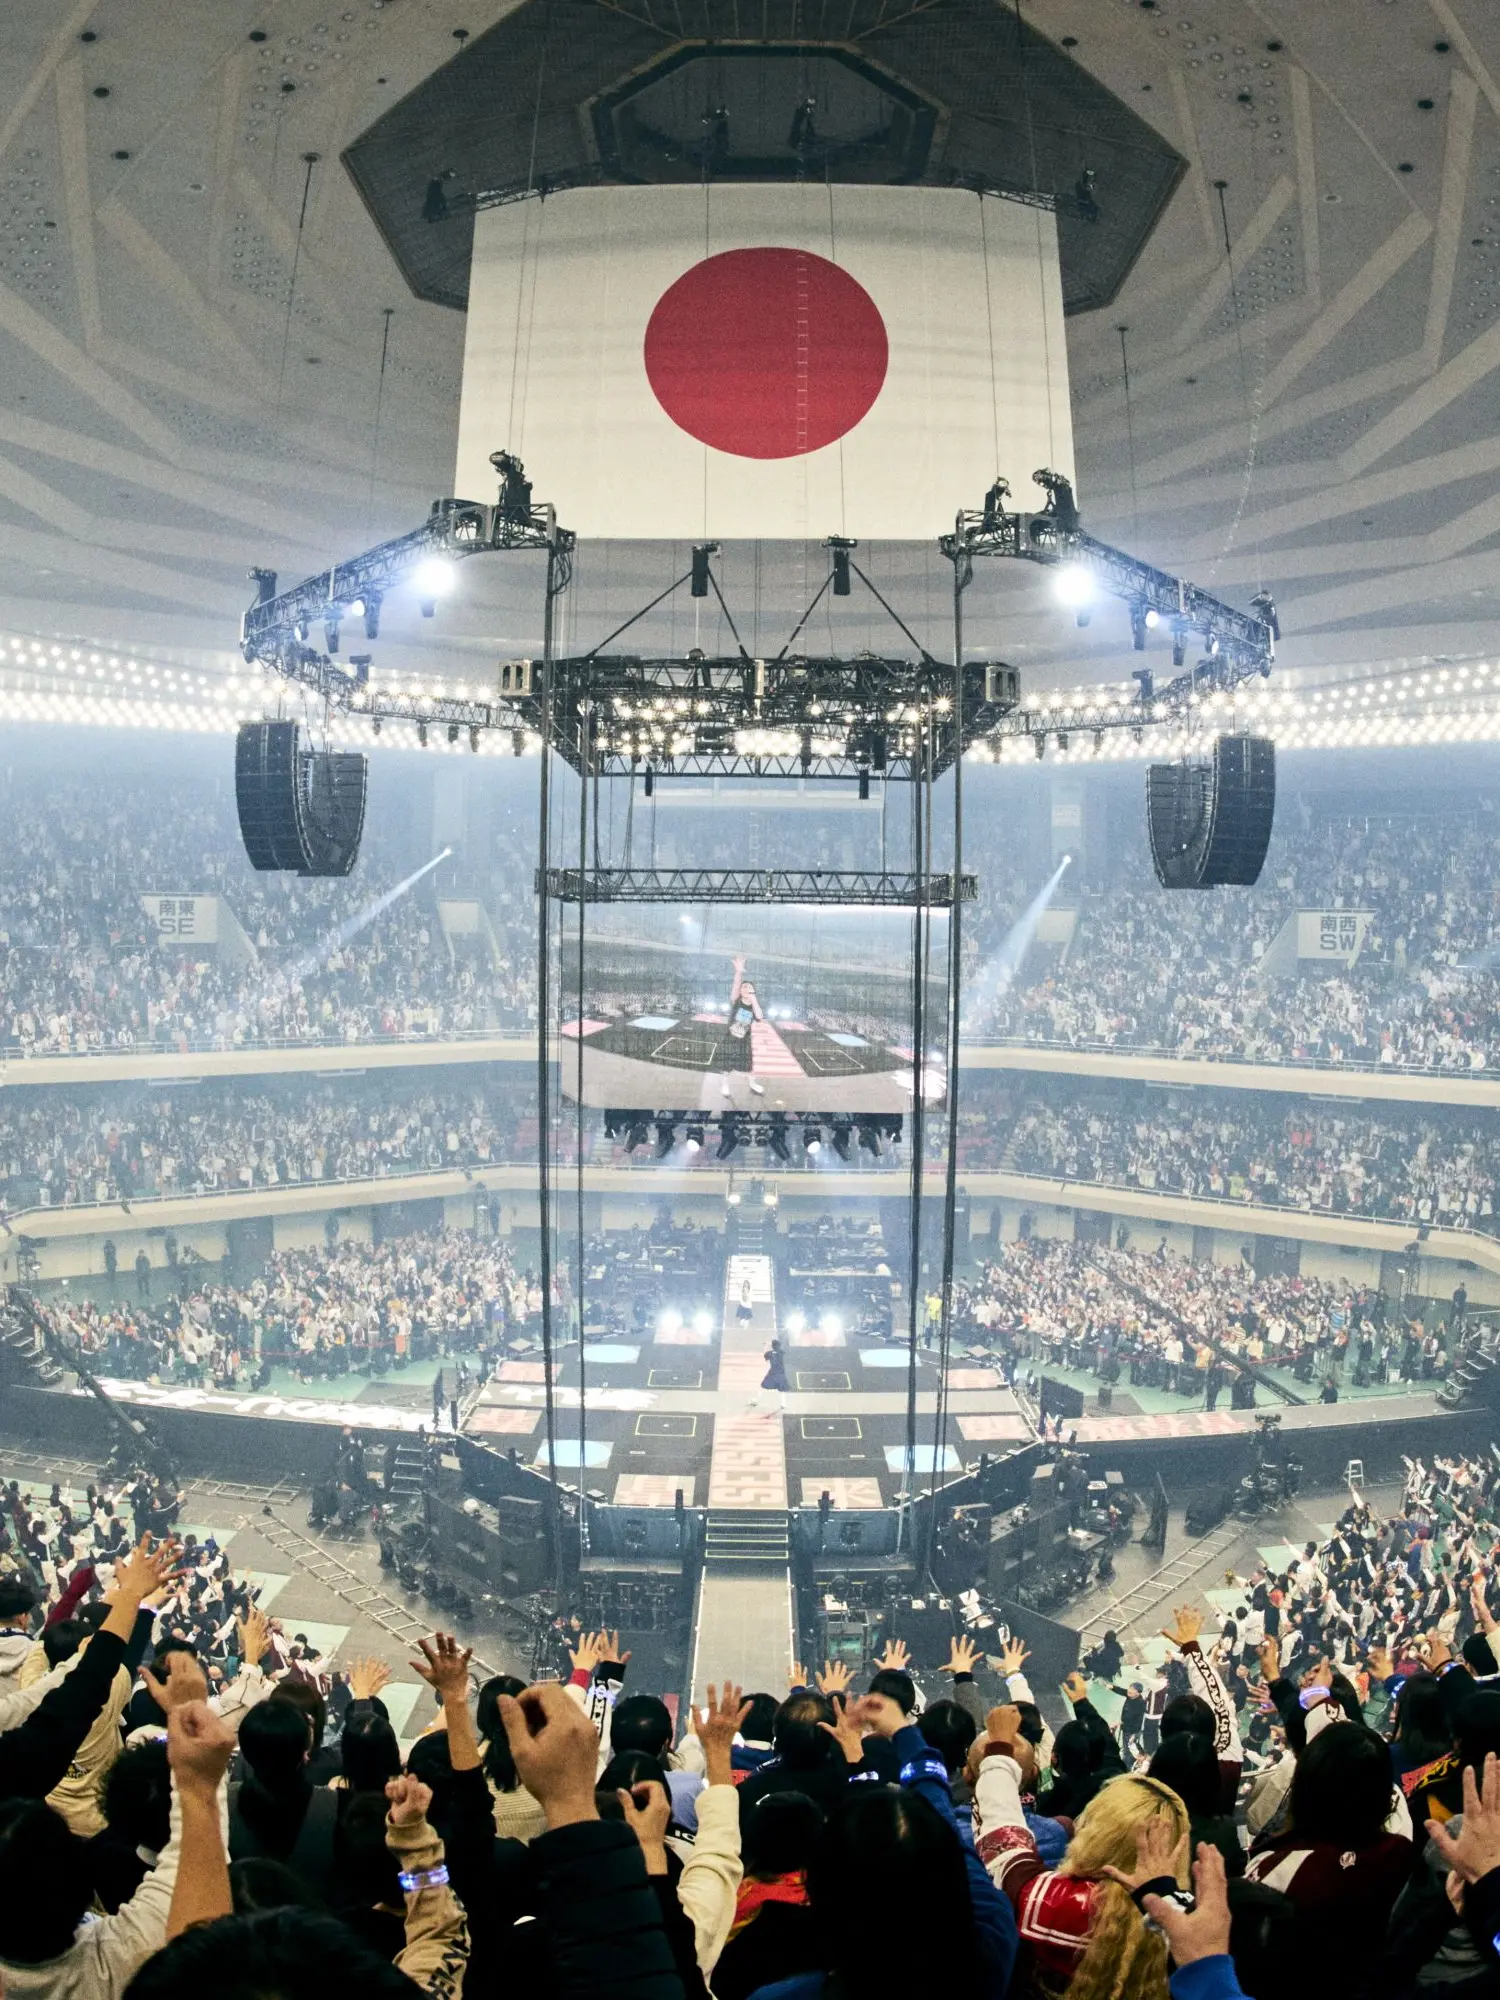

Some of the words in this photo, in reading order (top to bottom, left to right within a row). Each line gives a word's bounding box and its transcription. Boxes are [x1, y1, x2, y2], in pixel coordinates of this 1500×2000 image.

[159, 899, 195, 916] 南東
[159, 918, 195, 935] SE
[1320, 915, 1357, 932] 南西
[1320, 933, 1356, 951] SW
